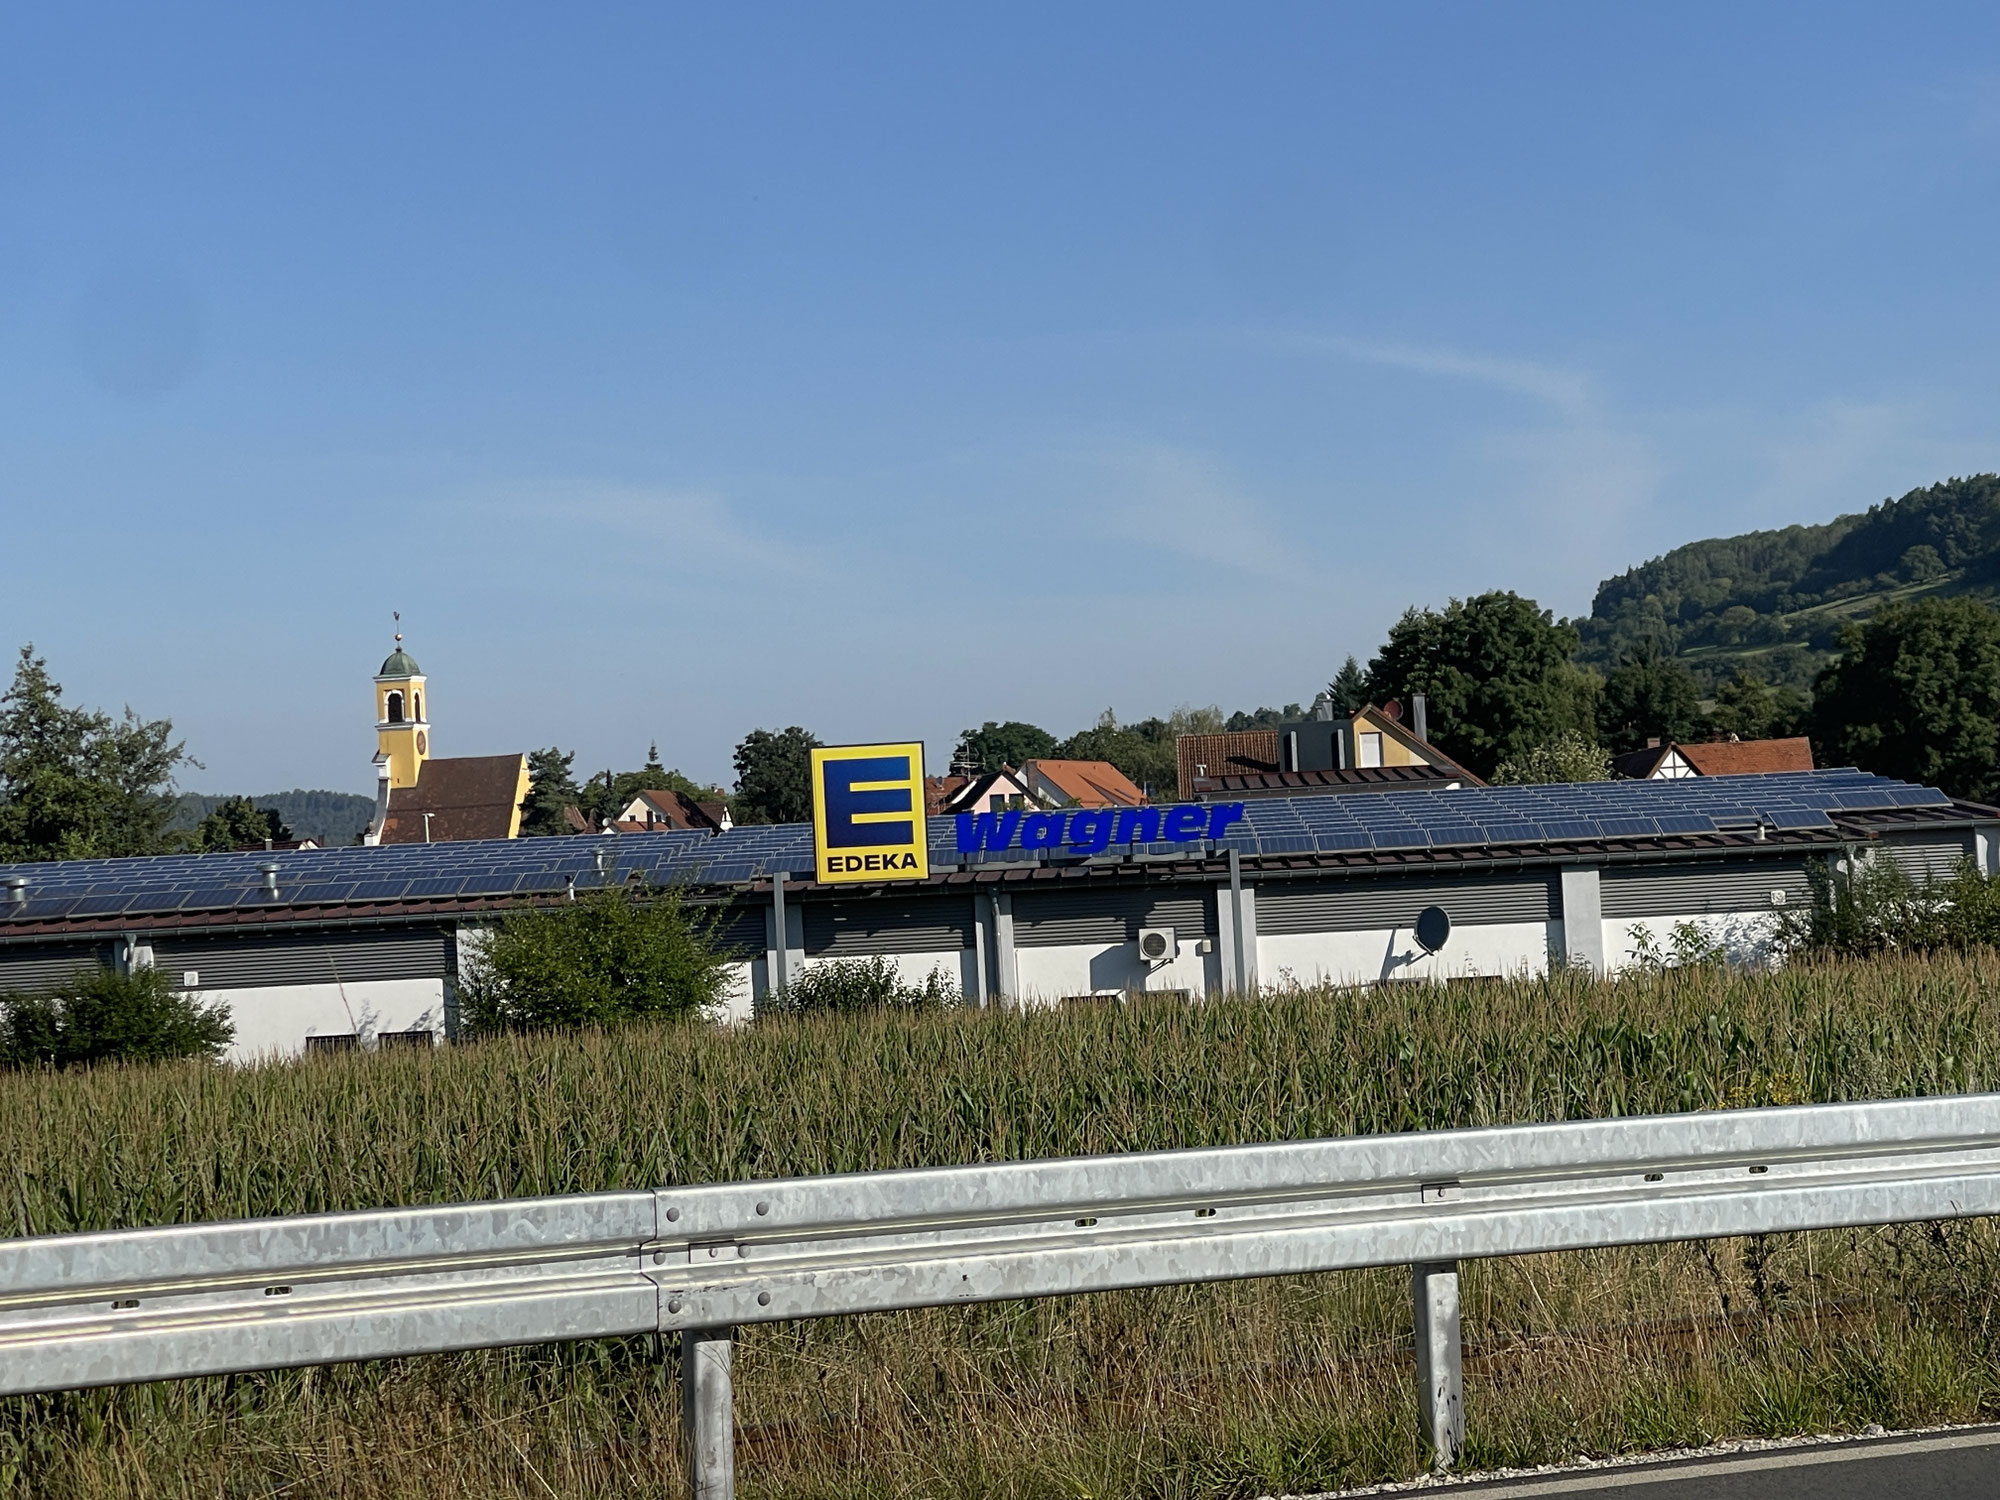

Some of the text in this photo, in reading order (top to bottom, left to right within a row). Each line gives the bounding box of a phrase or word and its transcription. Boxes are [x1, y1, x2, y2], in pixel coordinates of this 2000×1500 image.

[823, 757, 914, 848] E
[956, 803, 1244, 854] Wagner
[827, 853, 918, 873] EDEKA
